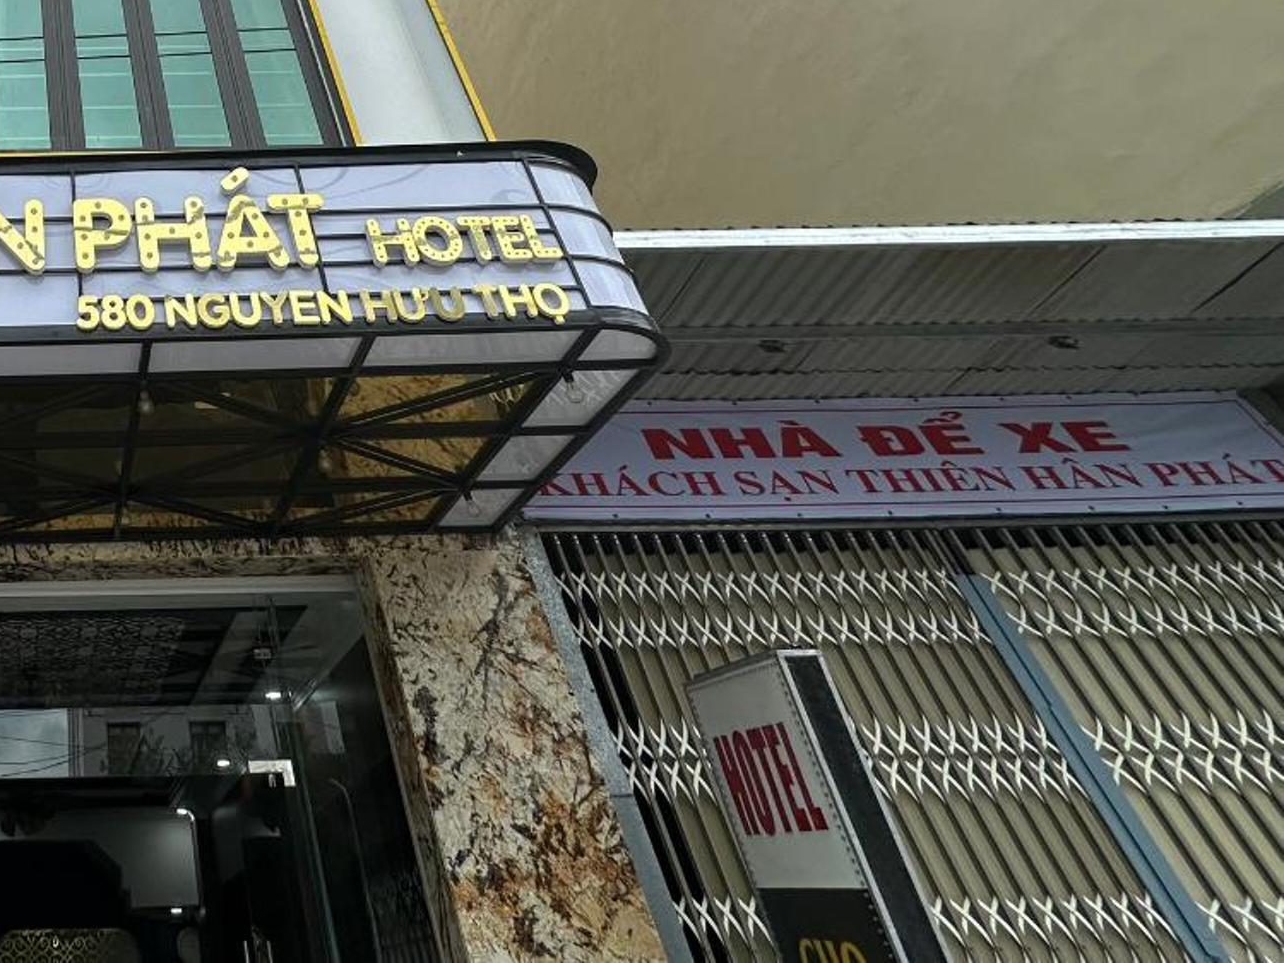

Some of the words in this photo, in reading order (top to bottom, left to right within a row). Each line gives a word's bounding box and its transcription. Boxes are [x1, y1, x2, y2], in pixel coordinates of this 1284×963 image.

[72, 167, 324, 274] PHÁT
[365, 213, 564, 267] HOTEL
[76, 294, 156, 332] 580
[473, 282, 571, 326] THỌ
[641, 420, 843, 460] NHÀ
[856, 411, 985, 456] ĐỂ
[998, 421, 1132, 454] XE
[734, 469, 840, 502] SẠN
[846, 460, 1017, 493] THIÊN
[1018, 457, 1143, 490] HÂN
[1143, 452, 1284, 487] PHÁT
[714, 722, 829, 836] HOTEL
